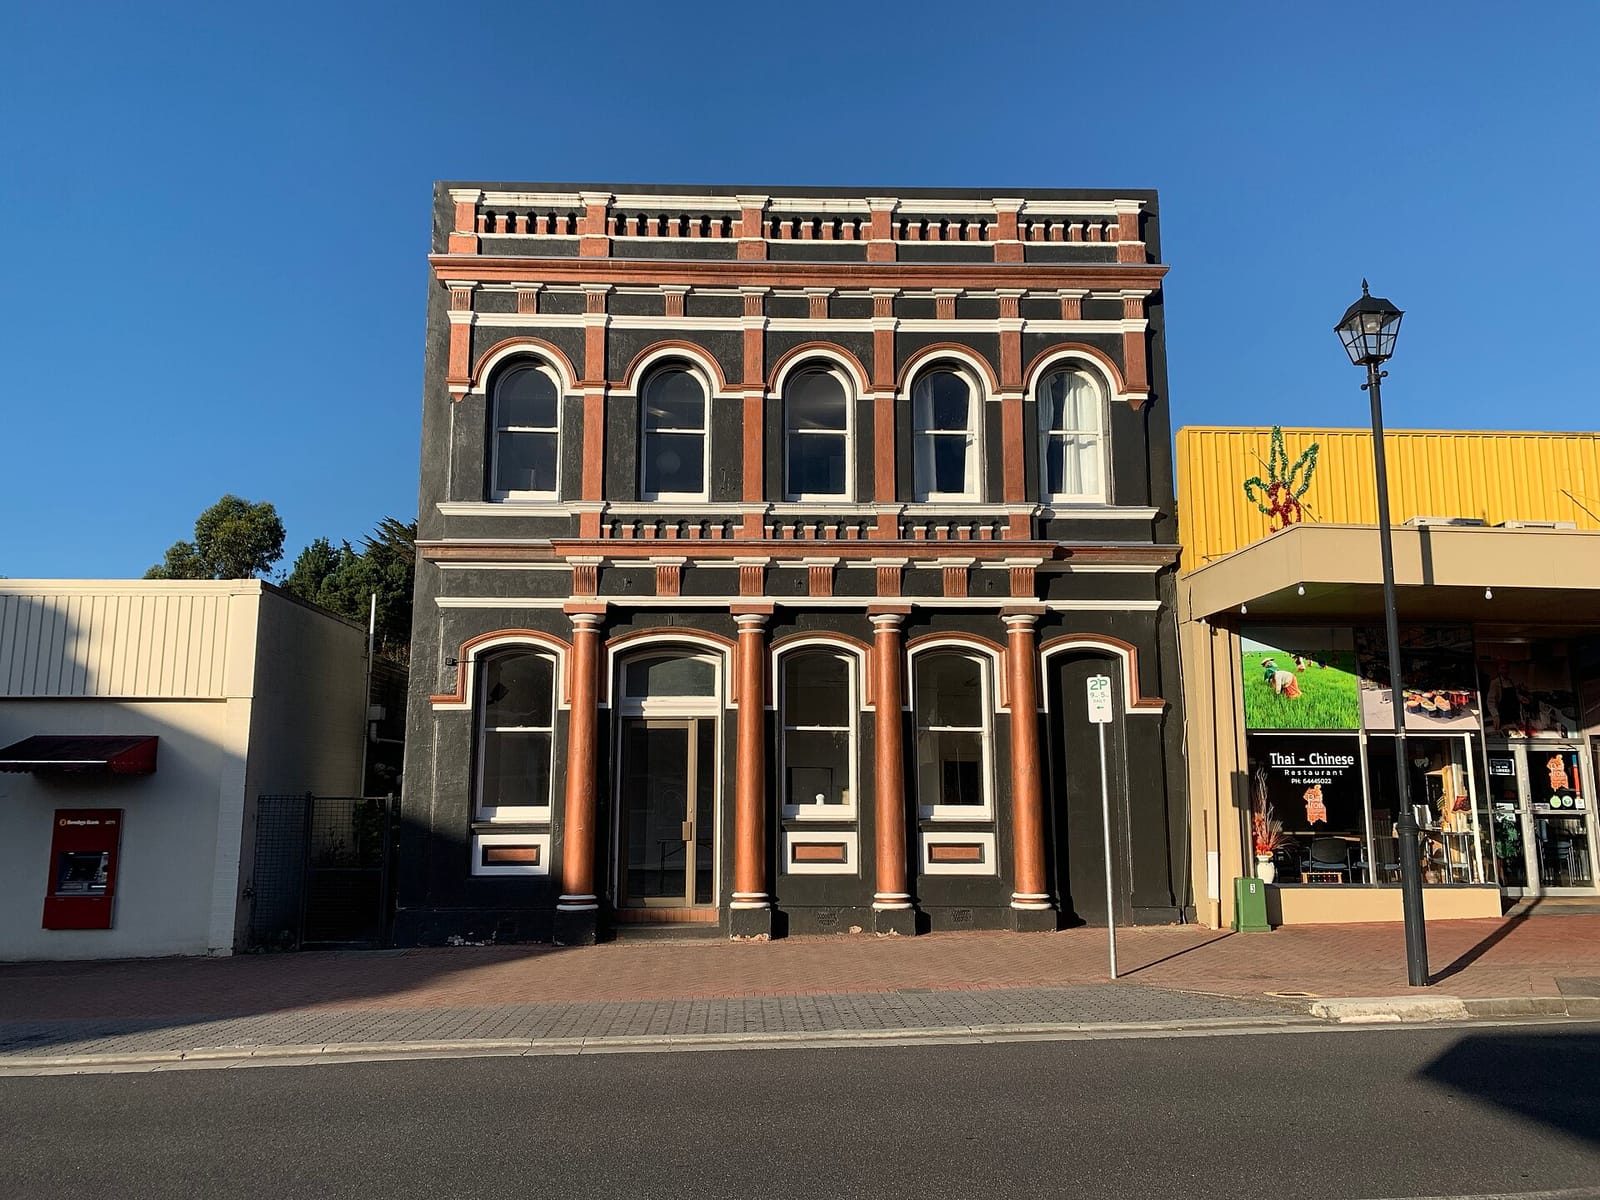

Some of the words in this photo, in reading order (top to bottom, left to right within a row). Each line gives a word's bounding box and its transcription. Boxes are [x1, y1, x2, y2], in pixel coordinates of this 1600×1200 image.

[1090, 680, 1108, 690] 2P
[1270, 753, 1295, 764] Thai
[1309, 753, 1354, 765] Chinese
